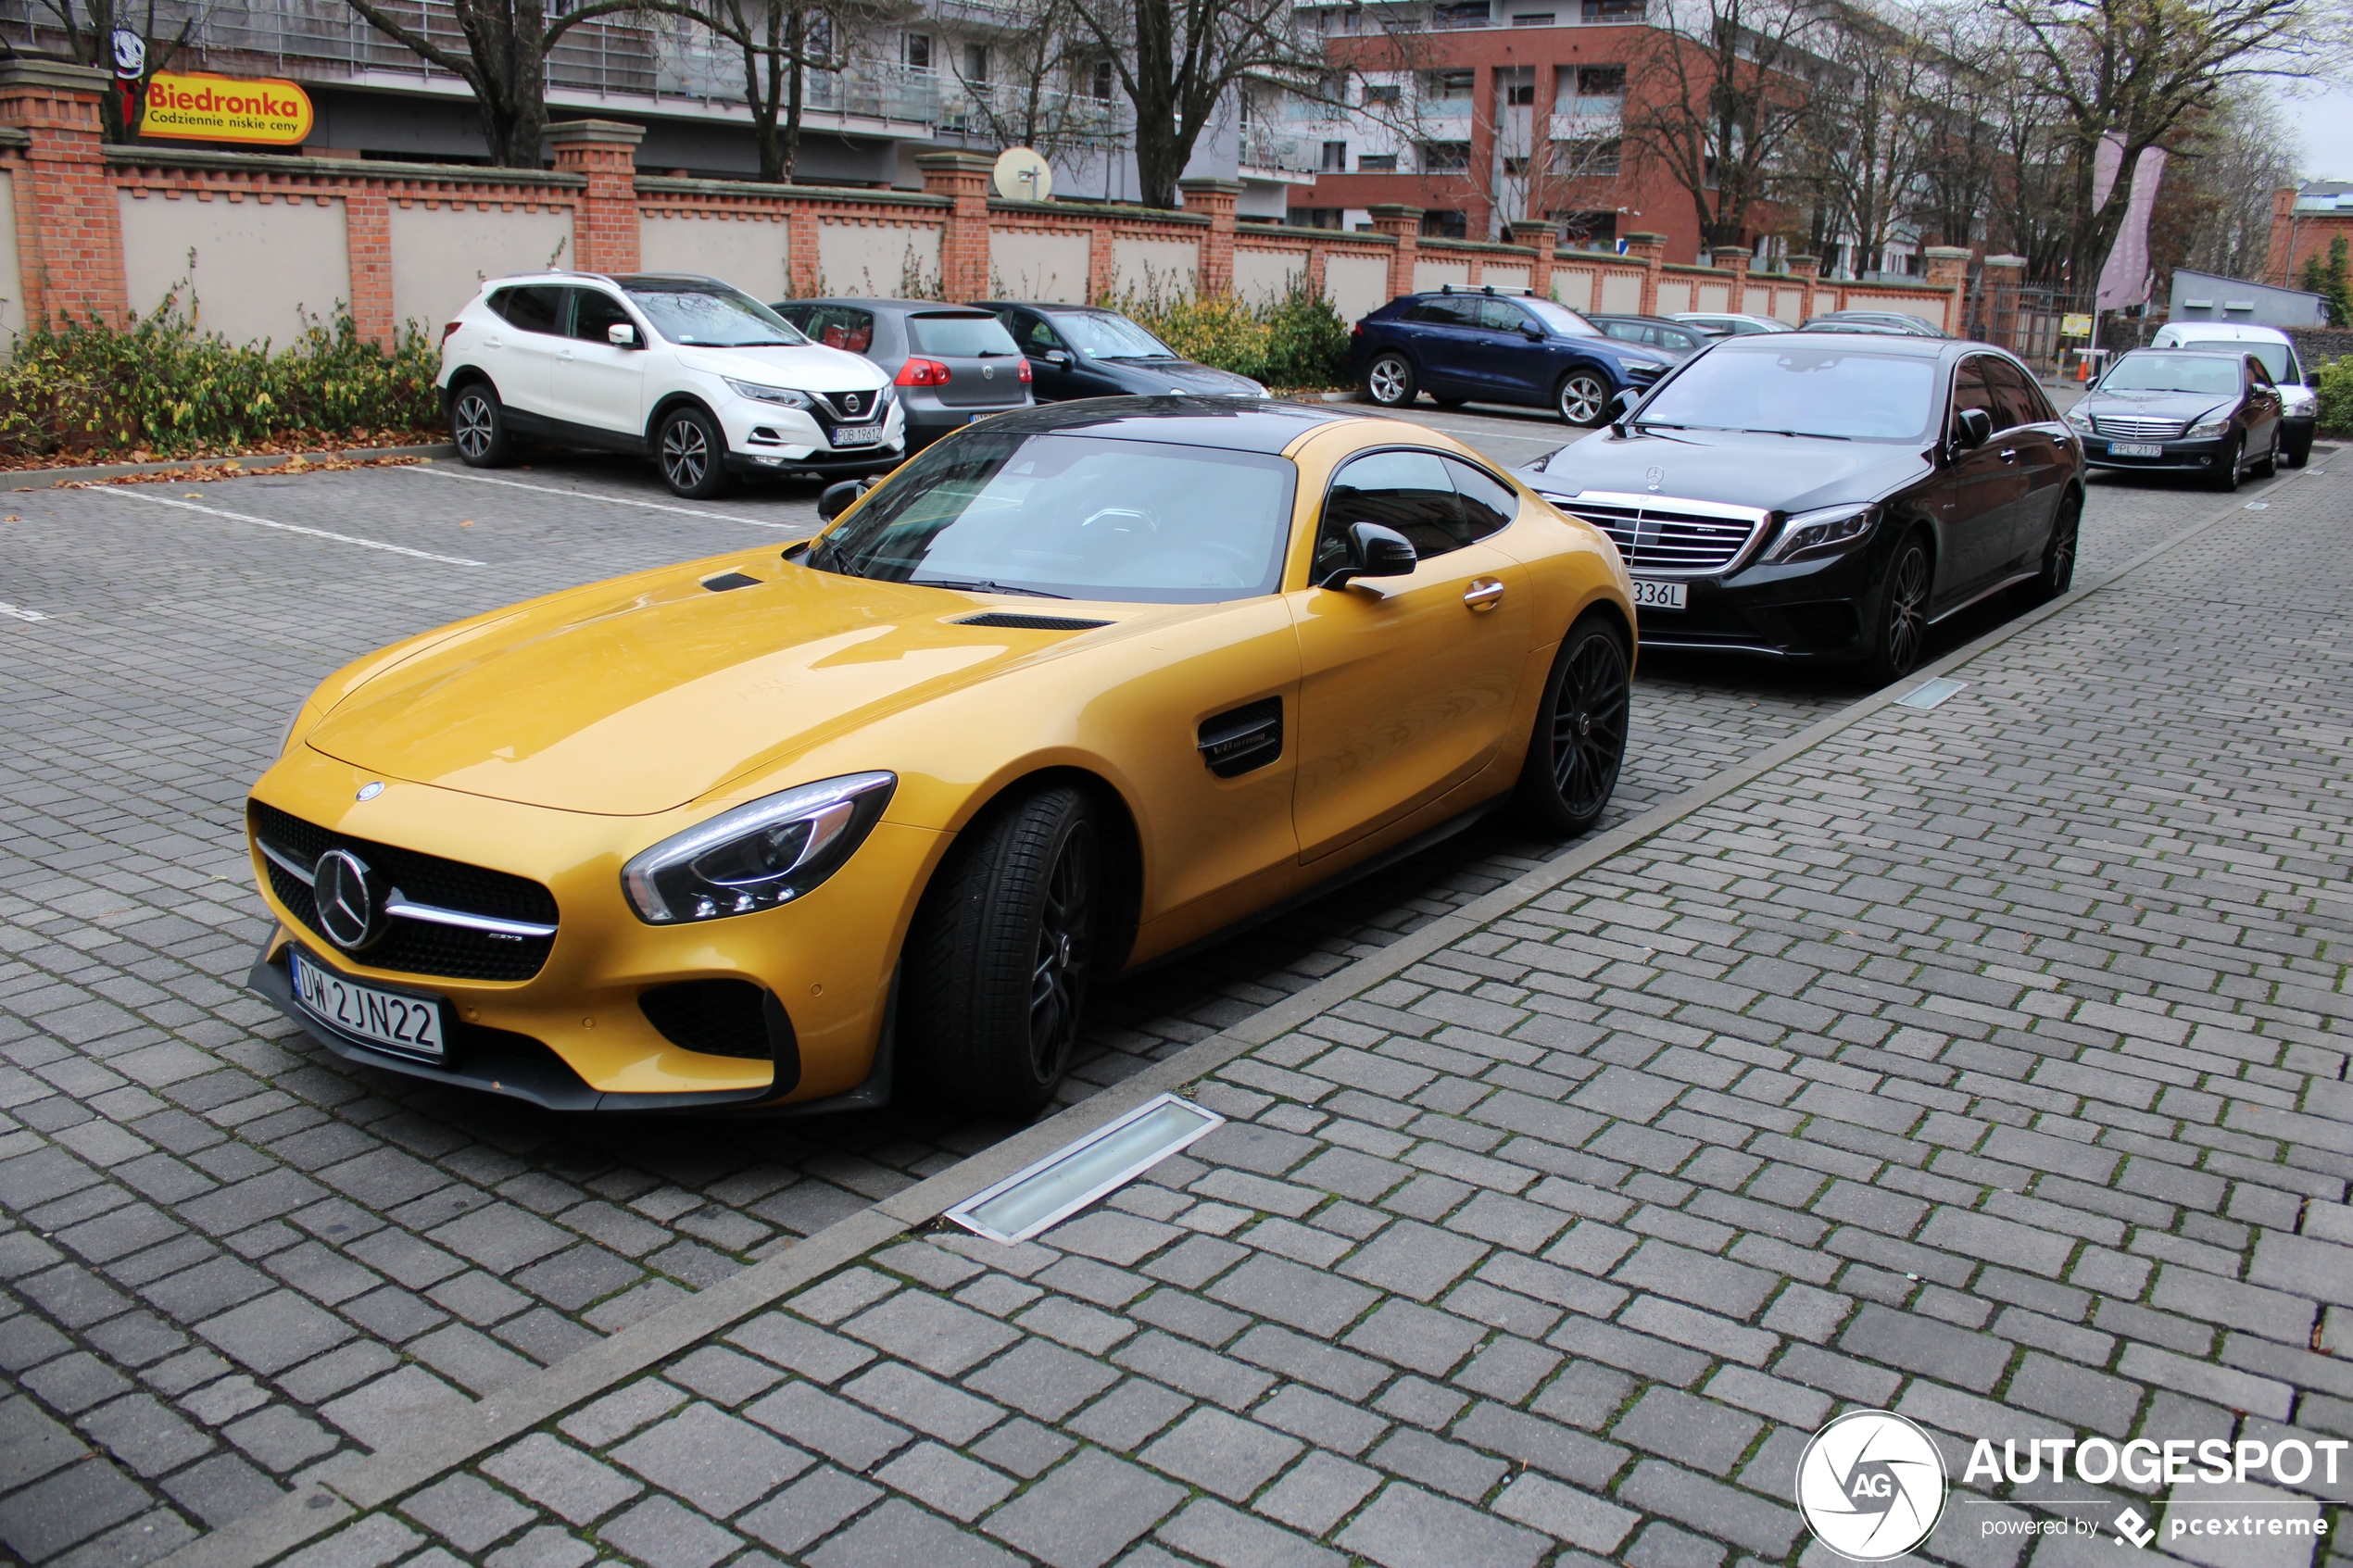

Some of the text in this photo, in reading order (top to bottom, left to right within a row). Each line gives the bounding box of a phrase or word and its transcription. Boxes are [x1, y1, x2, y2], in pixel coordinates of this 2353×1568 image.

[148, 82, 298, 118] Biedronka
[150, 110, 298, 133] Codziennie niskie ceny
[837, 427, 881, 441] POB 19612
[2112, 445, 2132, 454] PPL
[1632, 582, 1682, 607] 336L
[299, 961, 435, 1047] DW 2JN22
